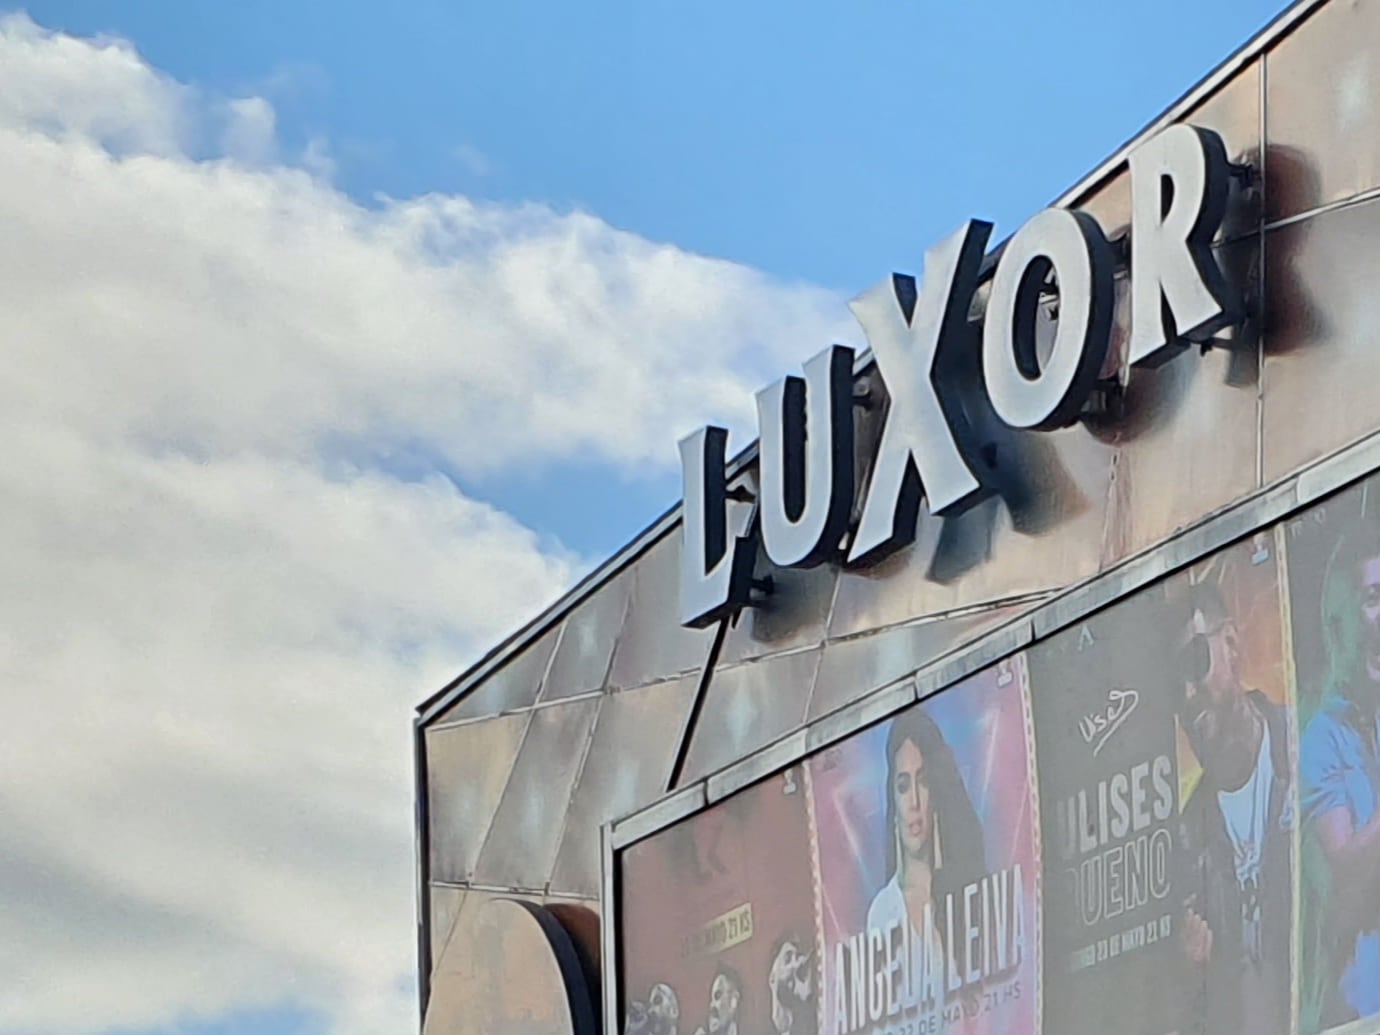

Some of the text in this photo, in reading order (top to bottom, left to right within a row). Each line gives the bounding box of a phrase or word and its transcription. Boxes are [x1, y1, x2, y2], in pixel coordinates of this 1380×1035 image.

[677, 123, 1230, 630] LUXOR
[948, 862, 1024, 992] LEIVA
[1066, 838, 1172, 926] UENO
